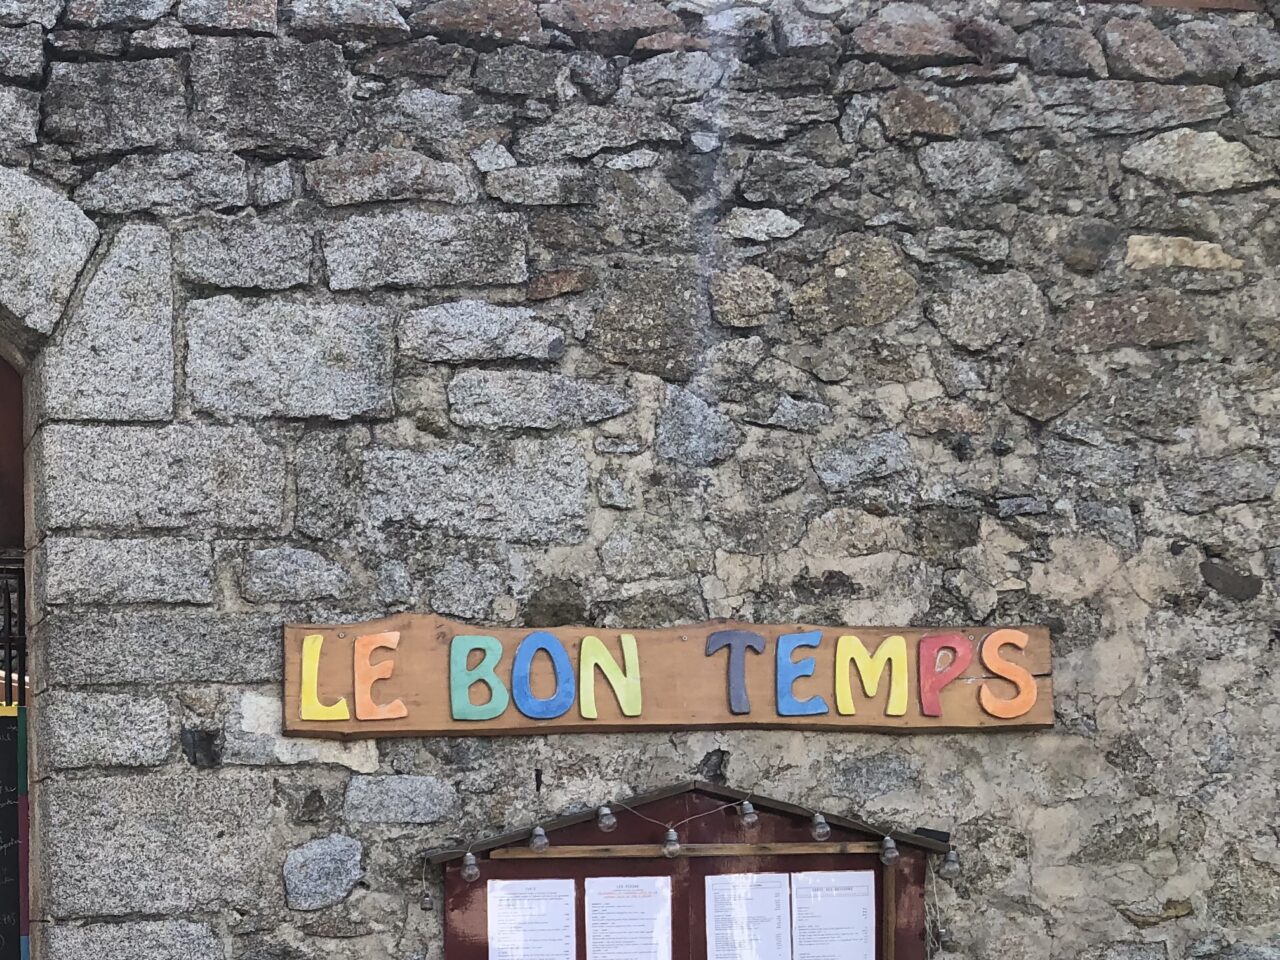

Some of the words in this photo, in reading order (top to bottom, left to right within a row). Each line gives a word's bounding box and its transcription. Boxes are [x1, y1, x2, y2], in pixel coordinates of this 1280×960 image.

[299, 630, 408, 722] LE
[449, 630, 643, 721] BON
[704, 629, 1039, 720] TEMPS
